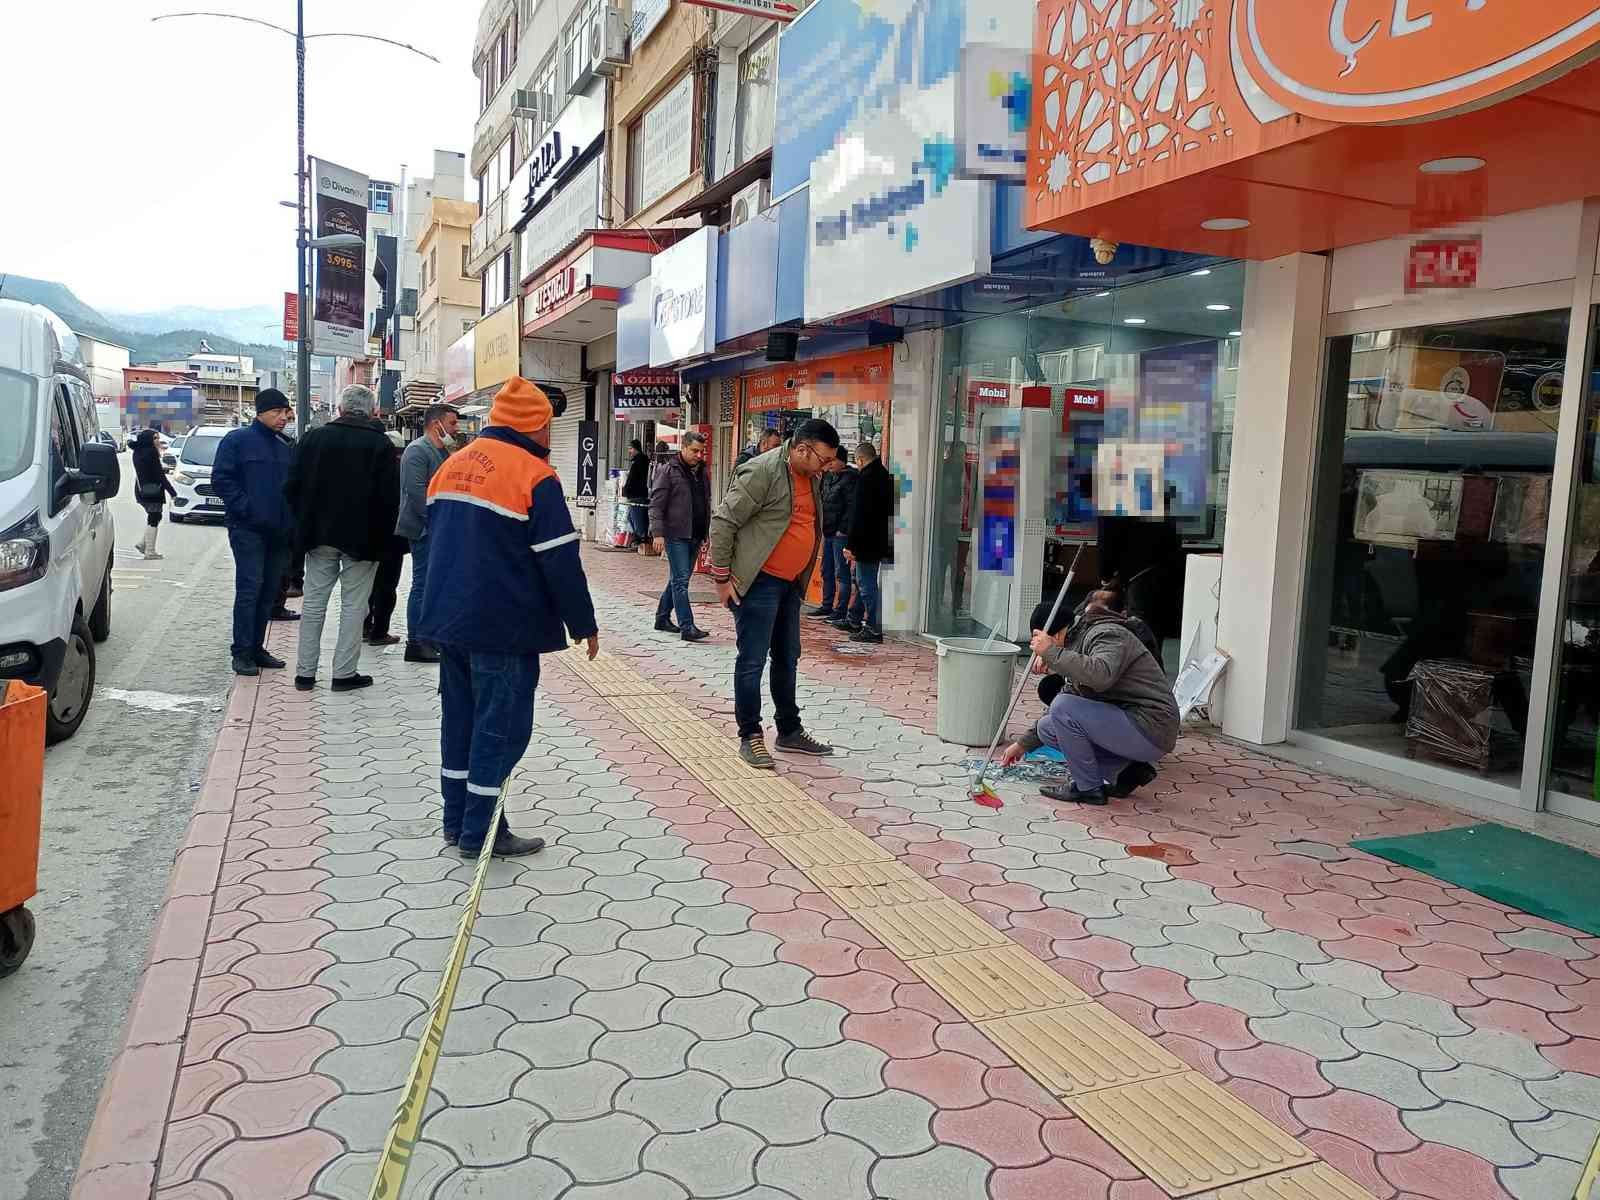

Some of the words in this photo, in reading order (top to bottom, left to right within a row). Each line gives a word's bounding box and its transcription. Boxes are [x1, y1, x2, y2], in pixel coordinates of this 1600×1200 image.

[624, 386, 670, 396] BAYAN
[979, 387, 1008, 399] Mobil
[618, 395, 677, 407] KUAFÖR
[582, 436, 595, 496] GALA
